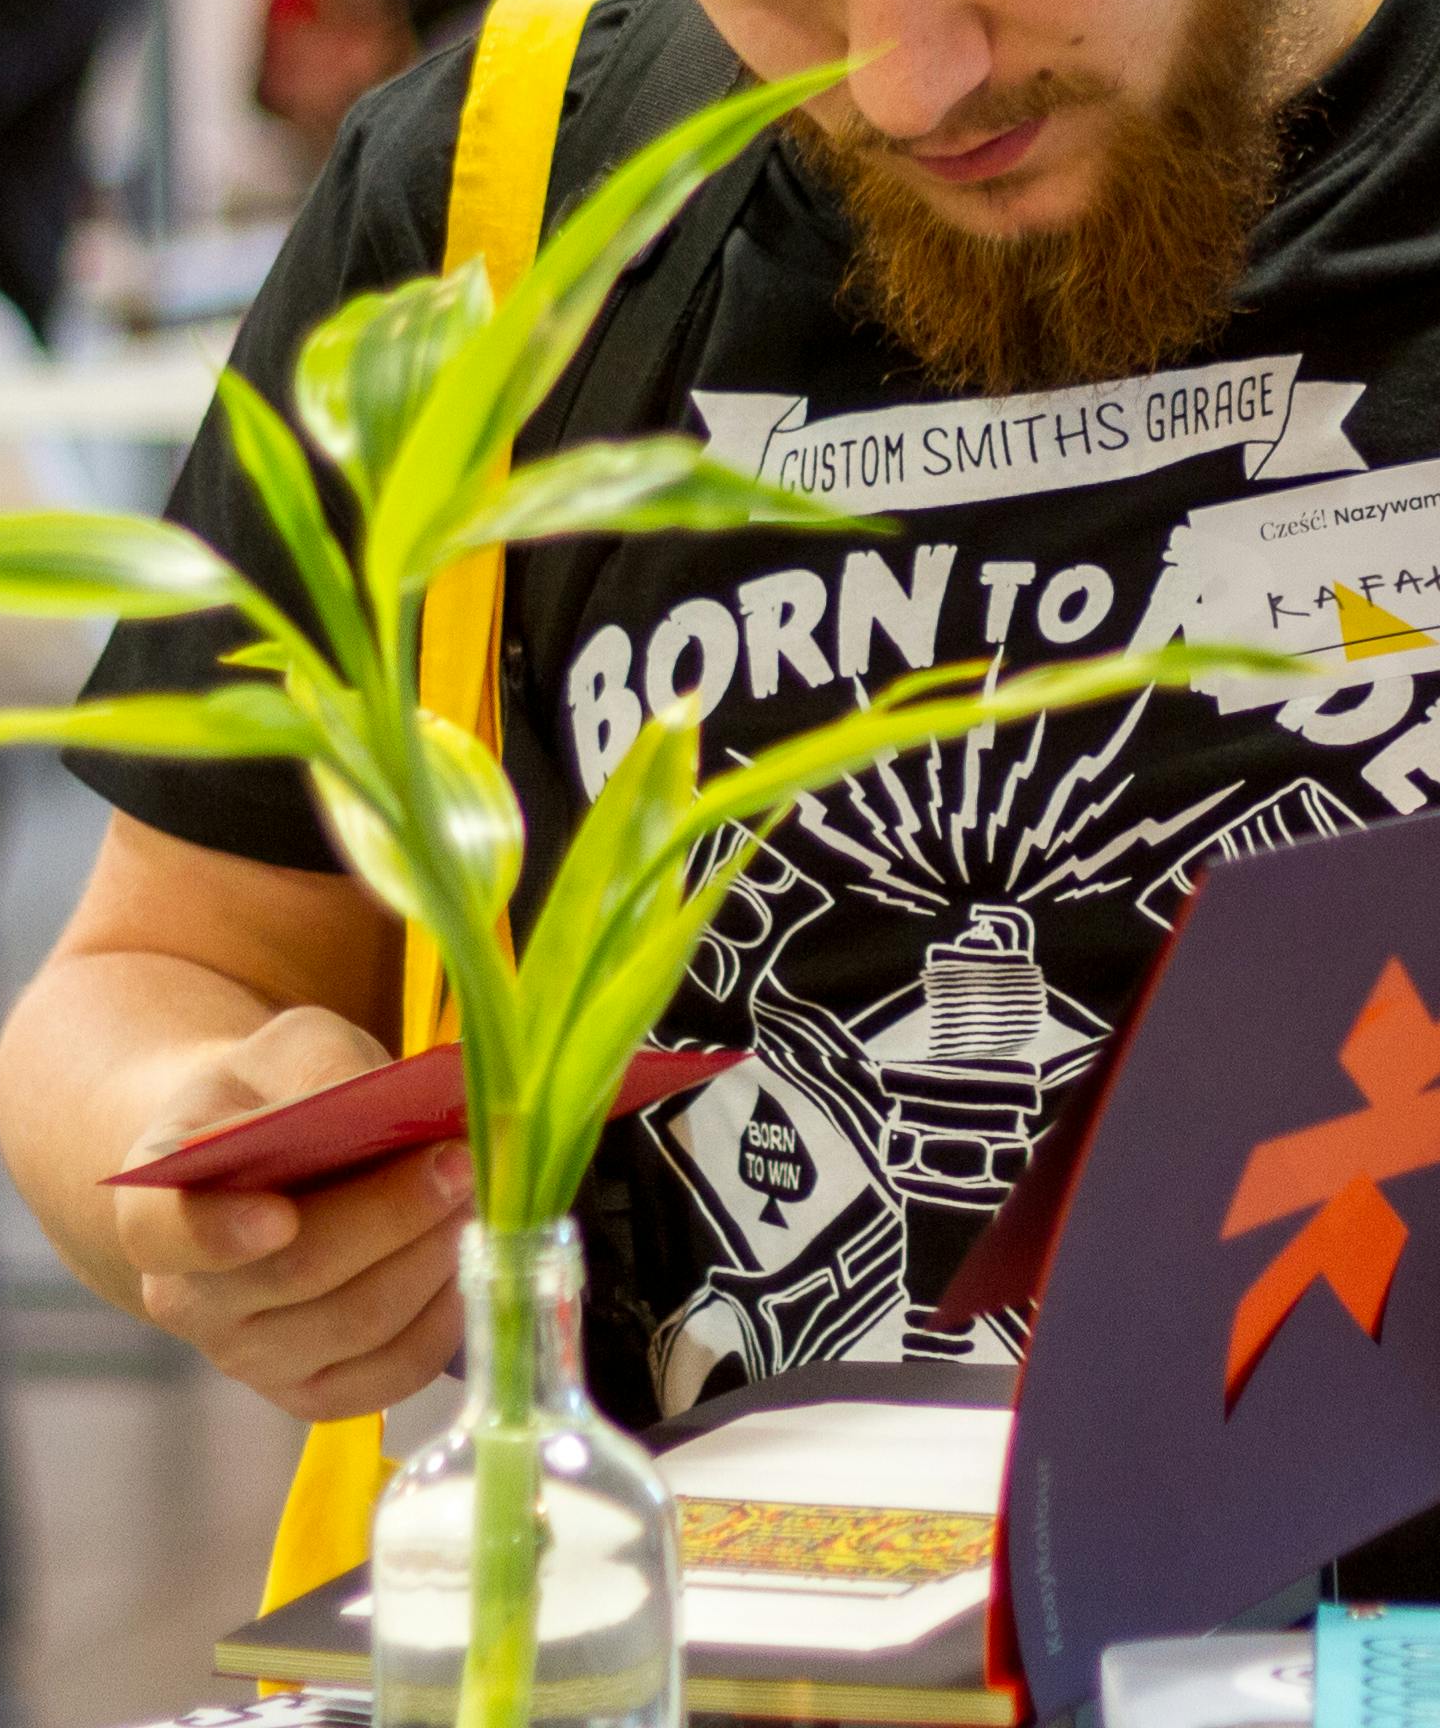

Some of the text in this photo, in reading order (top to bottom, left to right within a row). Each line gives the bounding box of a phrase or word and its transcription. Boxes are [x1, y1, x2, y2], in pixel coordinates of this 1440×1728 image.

[779, 372, 1275, 494] CUSTOM SMITHS GARAGE
[1259, 509, 1328, 542] Cześć!
[568, 544, 958, 806] BORN
[980, 561, 1115, 644] TO
[748, 1120, 796, 1154] BORN
[744, 1152, 801, 1191] TO WIN
